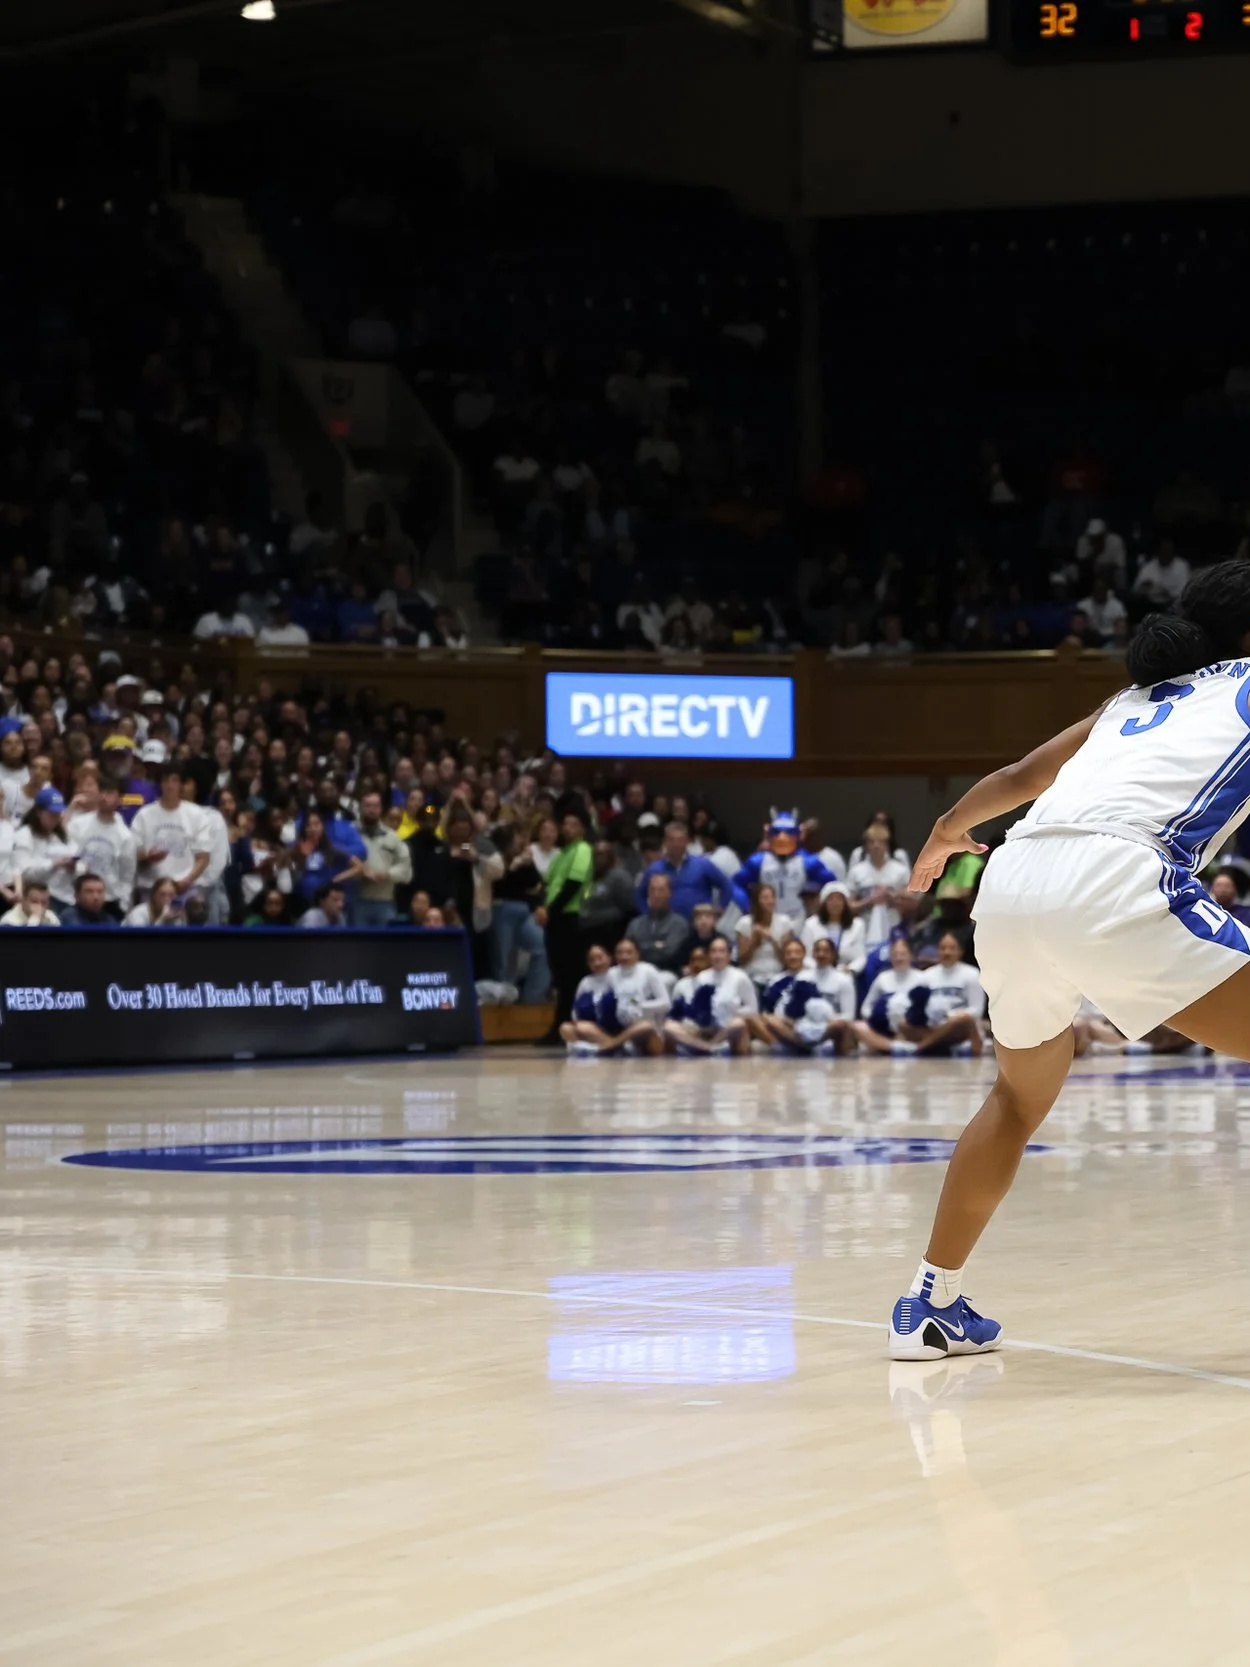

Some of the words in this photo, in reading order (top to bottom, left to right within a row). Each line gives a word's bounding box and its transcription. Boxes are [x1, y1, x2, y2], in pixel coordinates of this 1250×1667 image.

[1040, 3, 1078, 37] 32
[1184, 11, 1203, 41] 2
[569, 692, 771, 739] DIRECTV
[6, 987, 86, 1011] REEDS.com
[106, 982, 143, 1009] Over
[145, 983, 162, 1009] 30
[164, 982, 203, 1008] Hotel
[204, 982, 251, 1008] Brands
[252, 981, 271, 1007] for
[273, 981, 309, 1011] Every
[311, 980, 344, 1005] Kind
[345, 980, 359, 1004] of
[360, 979, 383, 1004] Fan
[402, 987, 459, 1011] BONVOY
